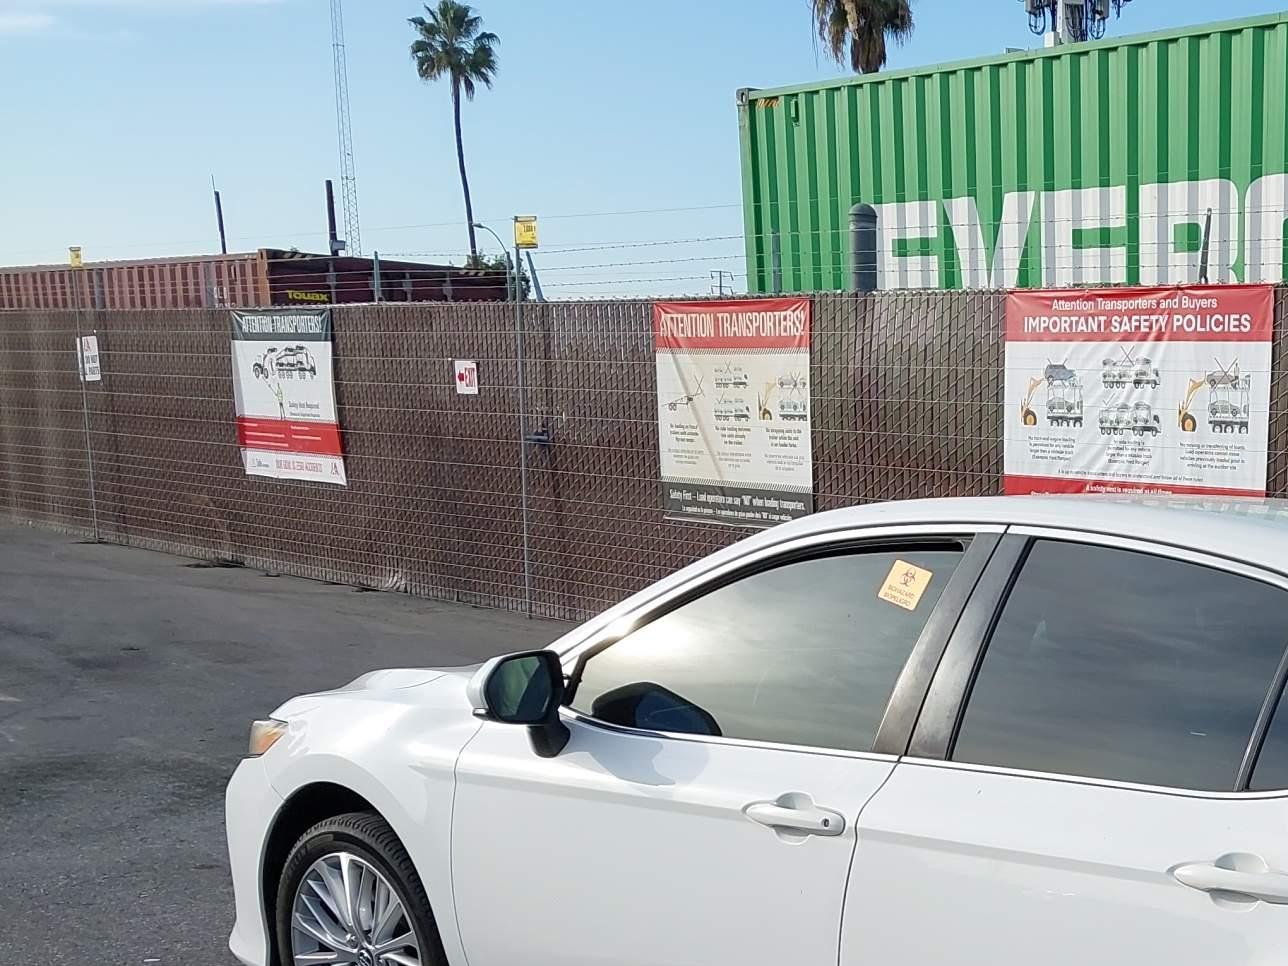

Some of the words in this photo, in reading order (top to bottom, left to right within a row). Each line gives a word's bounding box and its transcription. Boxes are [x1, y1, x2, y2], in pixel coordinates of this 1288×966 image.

[1052, 298, 1094, 311] Attention
[1097, 297, 1157, 312] Transporters
[1160, 296, 1178, 309] and
[1182, 295, 1217, 312] Buyers
[660, 313, 714, 337] ATTENTION
[717, 310, 805, 336] TRANSPORTERS!
[1024, 316, 1107, 333] IMPORTANT
[1111, 315, 1168, 333] SAFETY
[1173, 314, 1251, 332] POLICIES
